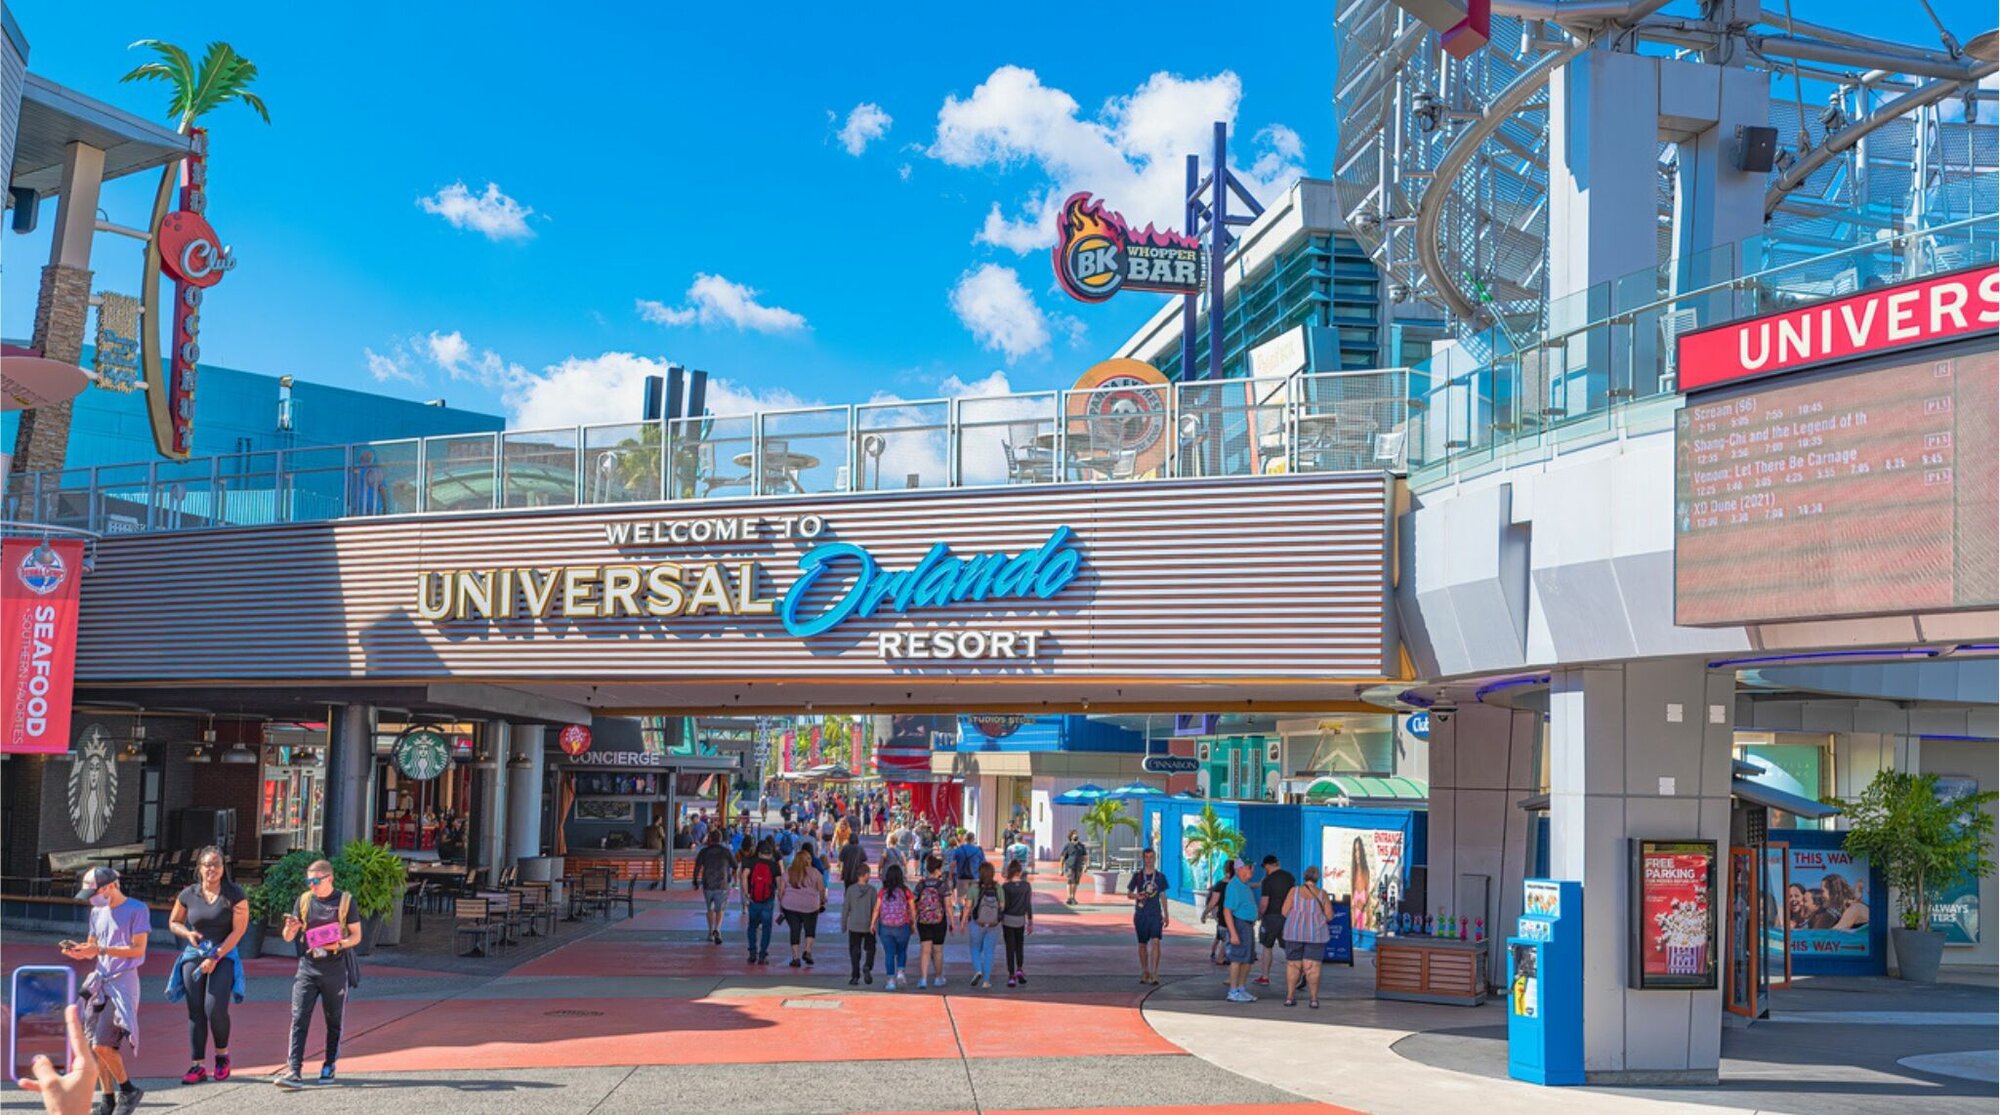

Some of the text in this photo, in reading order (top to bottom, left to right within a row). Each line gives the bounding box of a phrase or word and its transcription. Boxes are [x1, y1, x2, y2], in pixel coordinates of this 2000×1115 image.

[180, 238, 236, 278] Club
[1078, 245, 1119, 280] BK
[1127, 246, 1196, 261] WHOPPER
[1127, 257, 1197, 284] BAR
[1694, 404, 1732, 421] Scream
[1799, 401, 1823, 413] 10:45
[1694, 411, 1867, 453] Shang-Chi and the Legend of th
[1694, 448, 1857, 483] Venom: Let There Be Carnage
[1711, 499, 1737, 511] Dune
[1740, 492, 1776, 510] (2021)
[605, 515, 823, 544] WELCOME TO
[417, 525, 1082, 637] UNIVERSAL Orlando
[877, 629, 1042, 659] RESORT
[13, 613, 33, 745] SOUTHERN FAVORITES
[26, 605, 55, 737] SEAFOOD
[570, 751, 660, 766] CONCIERGE
[1148, 760, 1196, 769] CINNABON
[1645, 858, 1674, 868] FREE
[1794, 852, 1822, 864] THIS
[1827, 852, 1854, 864] WAY
[1645, 868, 1695, 879] PARKING
[1812, 940, 1840, 952] WAY
